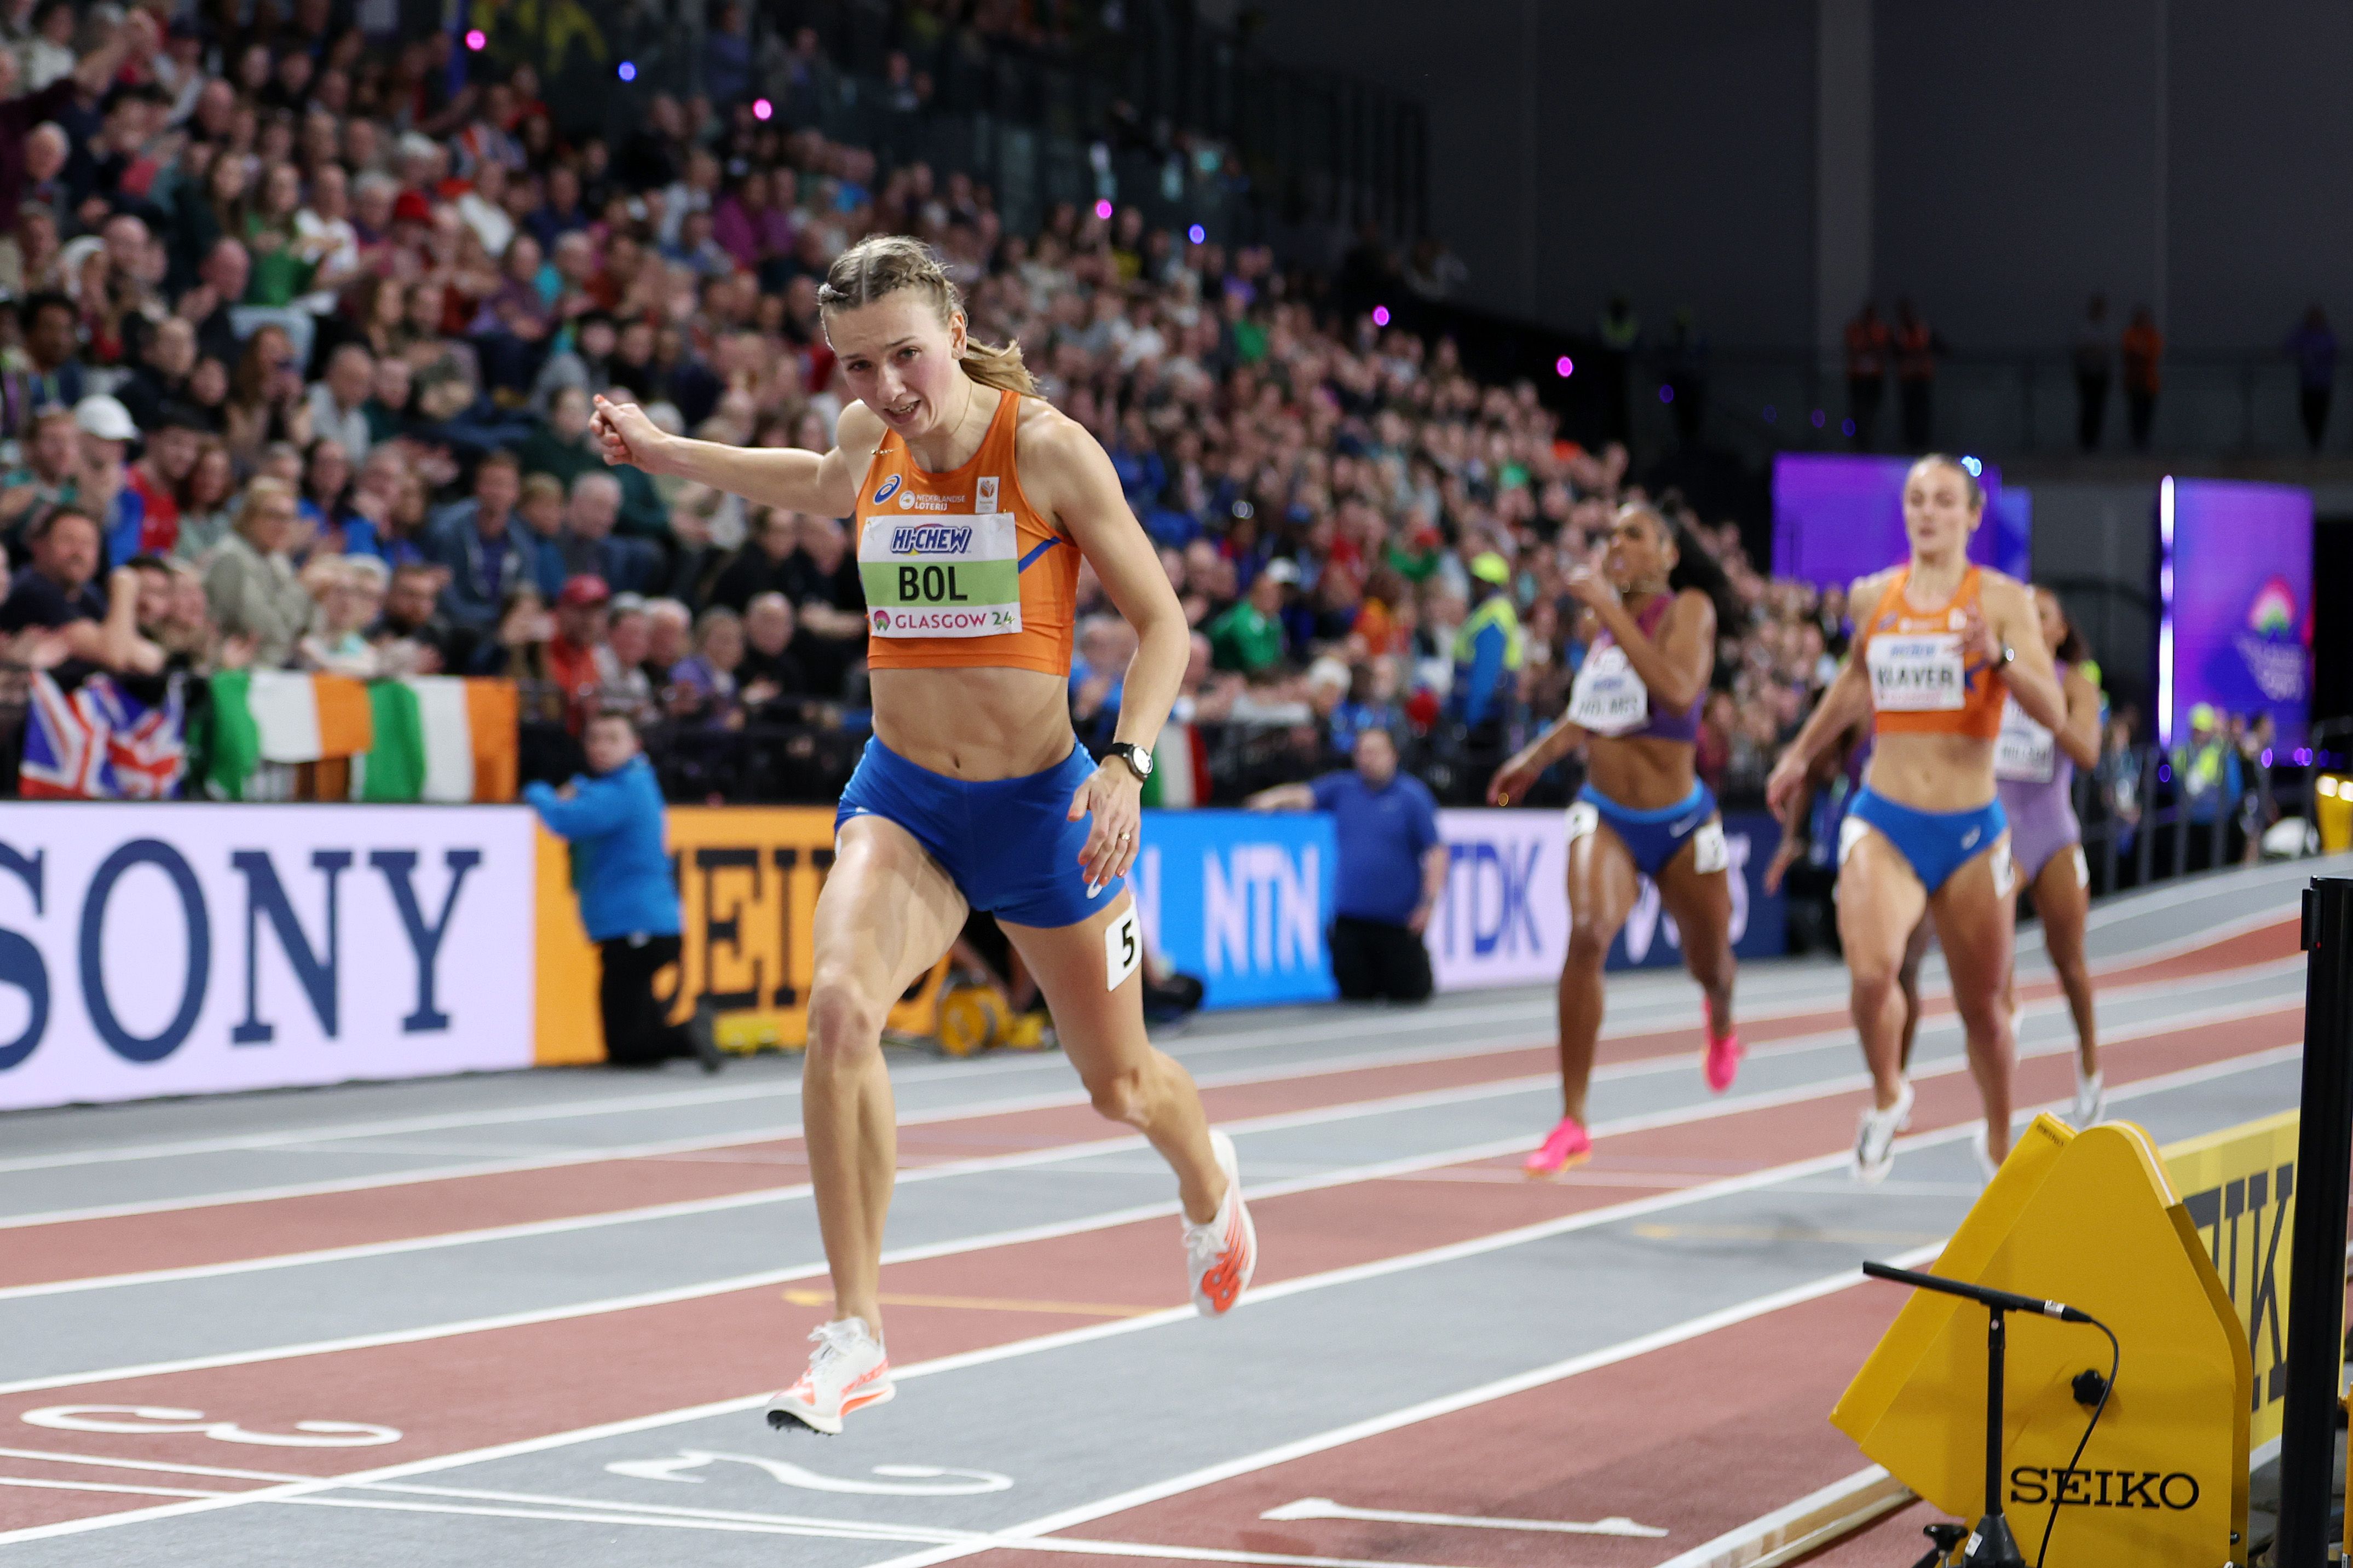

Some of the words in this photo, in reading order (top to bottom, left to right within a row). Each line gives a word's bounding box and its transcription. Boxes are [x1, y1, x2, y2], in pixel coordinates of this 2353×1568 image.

[915, 502, 948, 511] LOTERIJ
[916, 494, 966, 503] NEDERLANDSE
[891, 526, 972, 554] HI-CHEW
[899, 565, 968, 601] BOL
[895, 612, 987, 629] GLASGOW
[1204, 843, 1320, 974] NTN
[1122, 919, 1134, 968] 5
[2010, 1465, 2200, 1510] SEIKO
